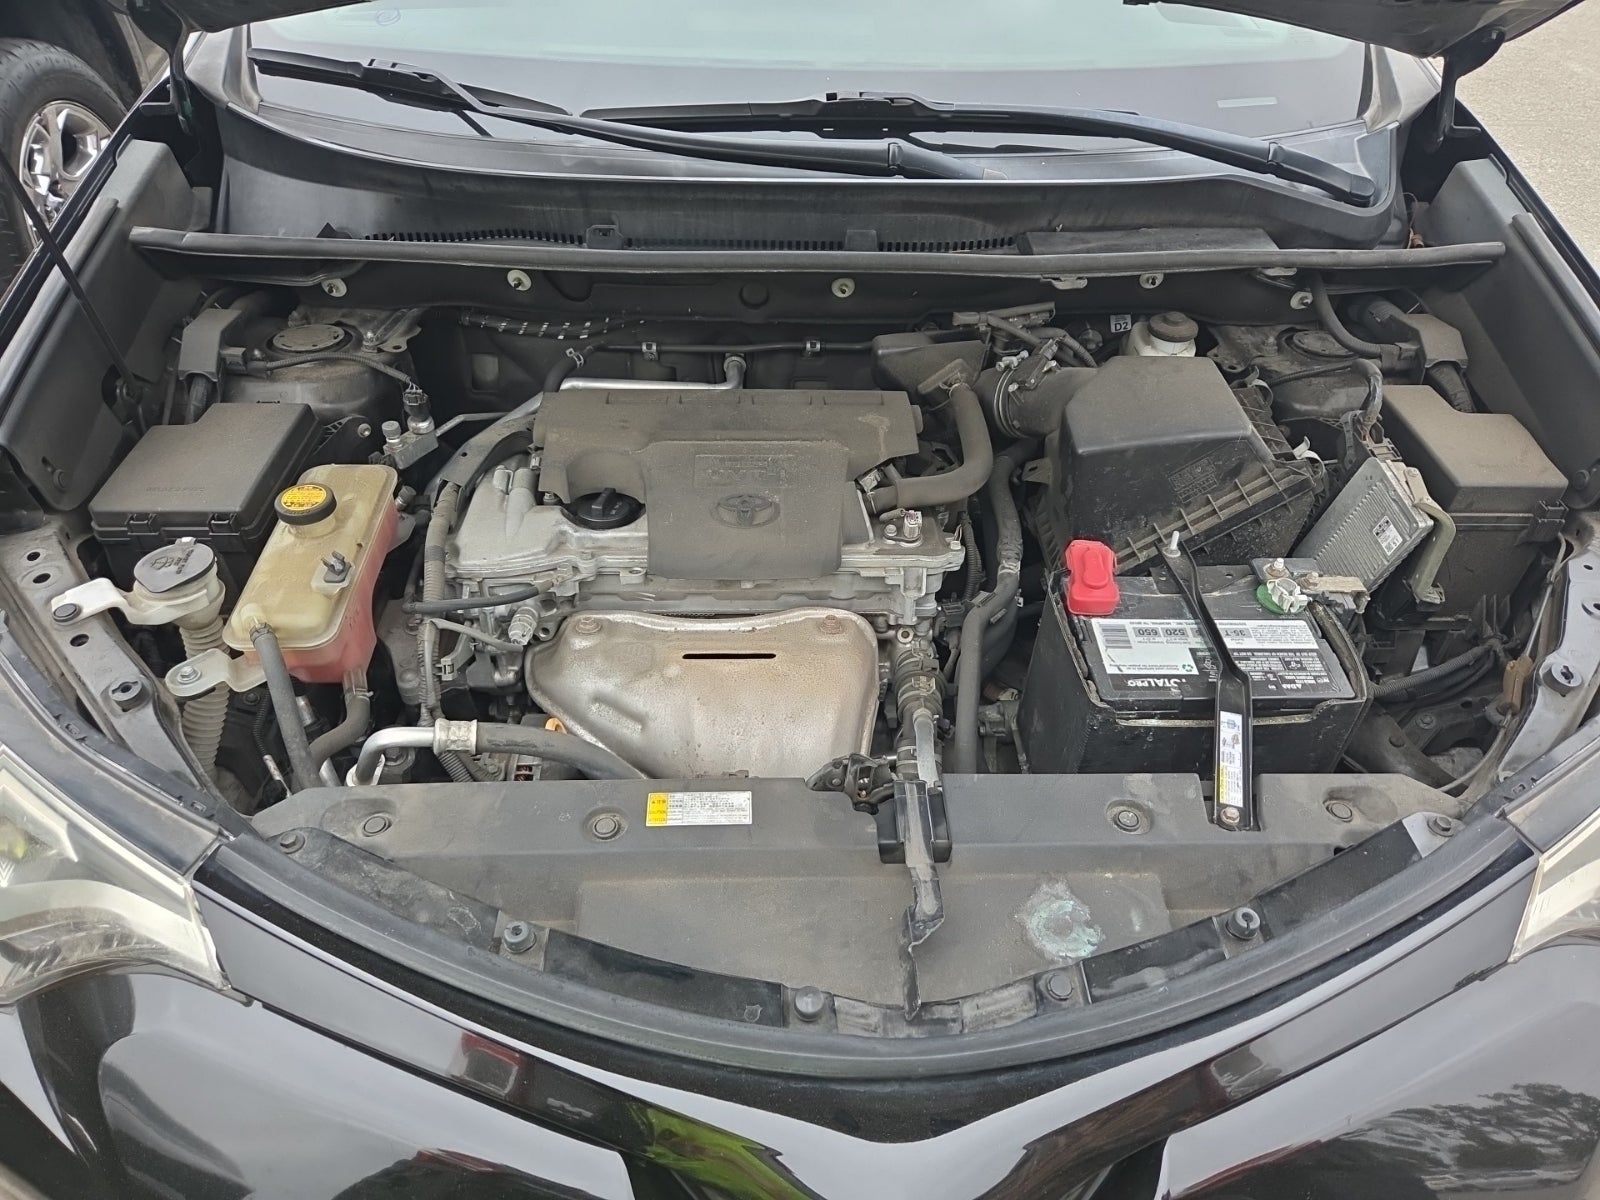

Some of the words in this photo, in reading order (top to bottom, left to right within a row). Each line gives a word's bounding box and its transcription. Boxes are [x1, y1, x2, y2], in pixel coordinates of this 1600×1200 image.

[1115, 322, 1129, 331] D2
[1138, 628, 1158, 636] 650
[1165, 628, 1186, 636] 520
